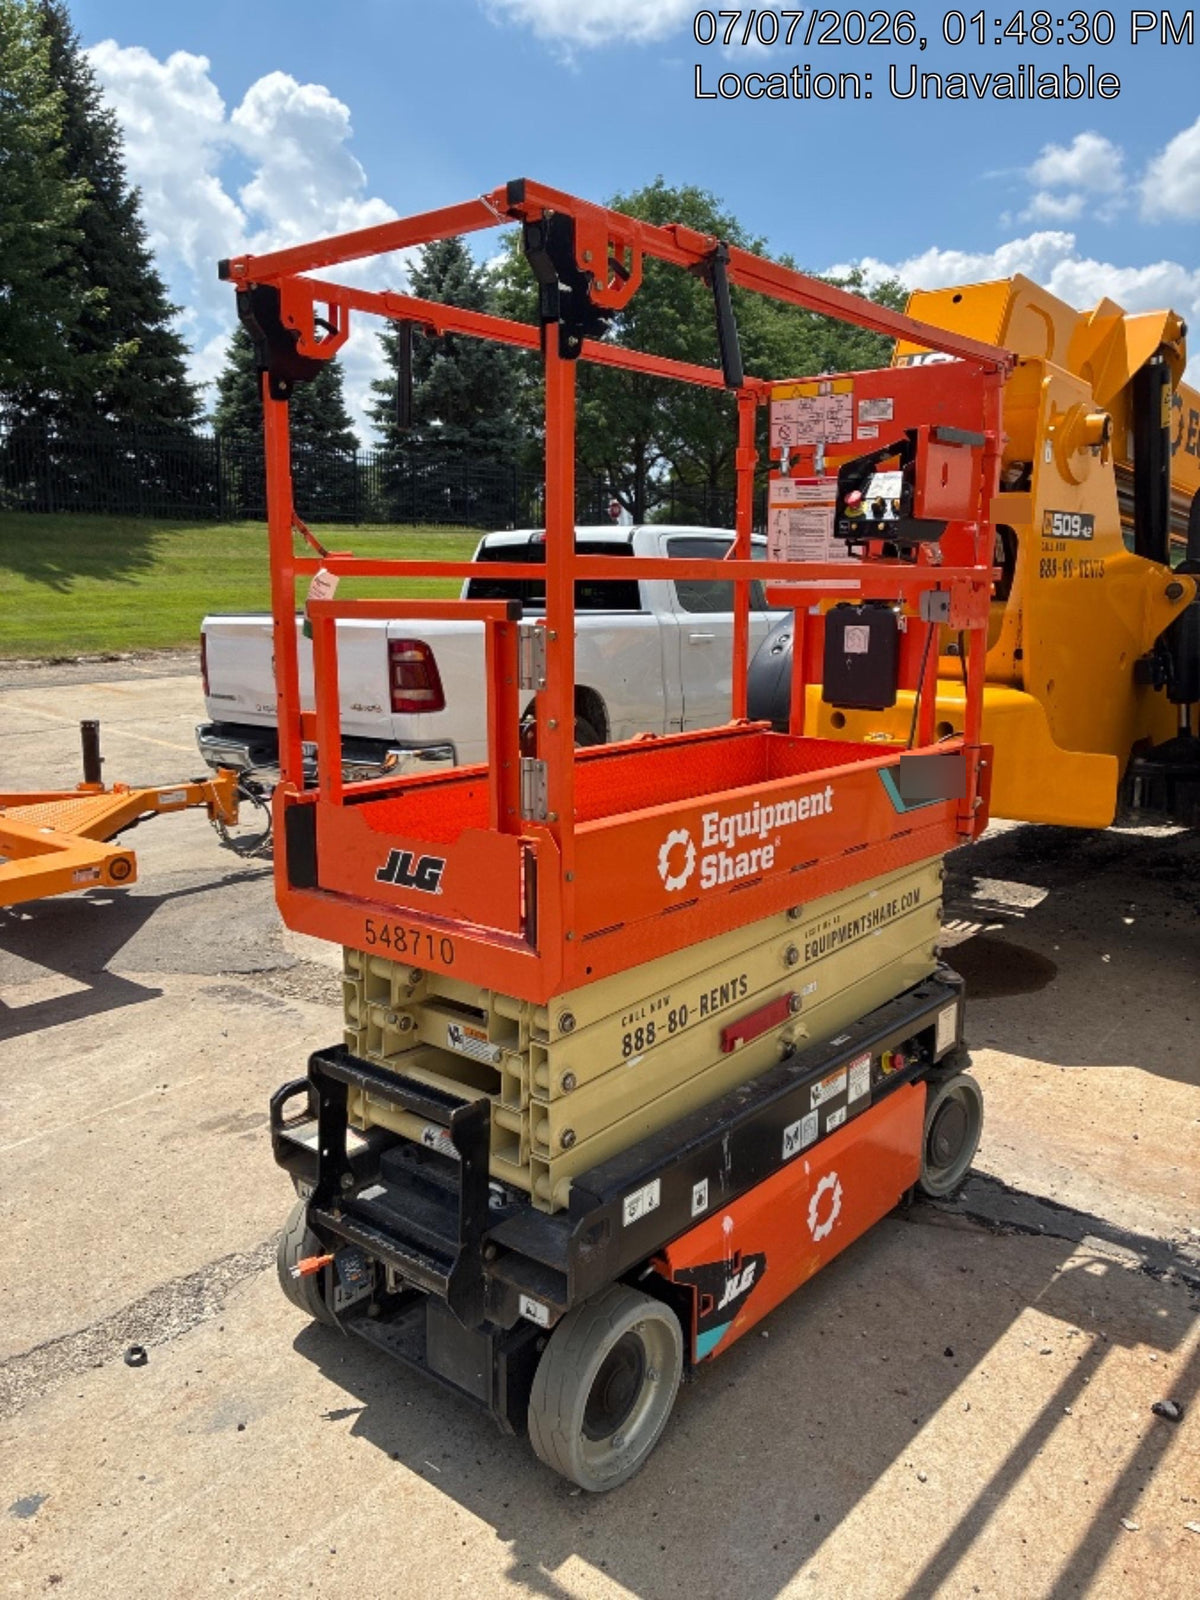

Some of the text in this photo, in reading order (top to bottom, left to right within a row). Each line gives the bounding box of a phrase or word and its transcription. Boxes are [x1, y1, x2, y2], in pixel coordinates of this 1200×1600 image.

[701, 785, 835, 849] Equipment
[374, 847, 447, 895] JLG
[364, 918, 455, 965] 548710
[804, 887, 922, 962] EQUIPMENTSHARE.COM
[621, 974, 748, 1058] 888-80-RENTS
[717, 1261, 757, 1311] JLG
